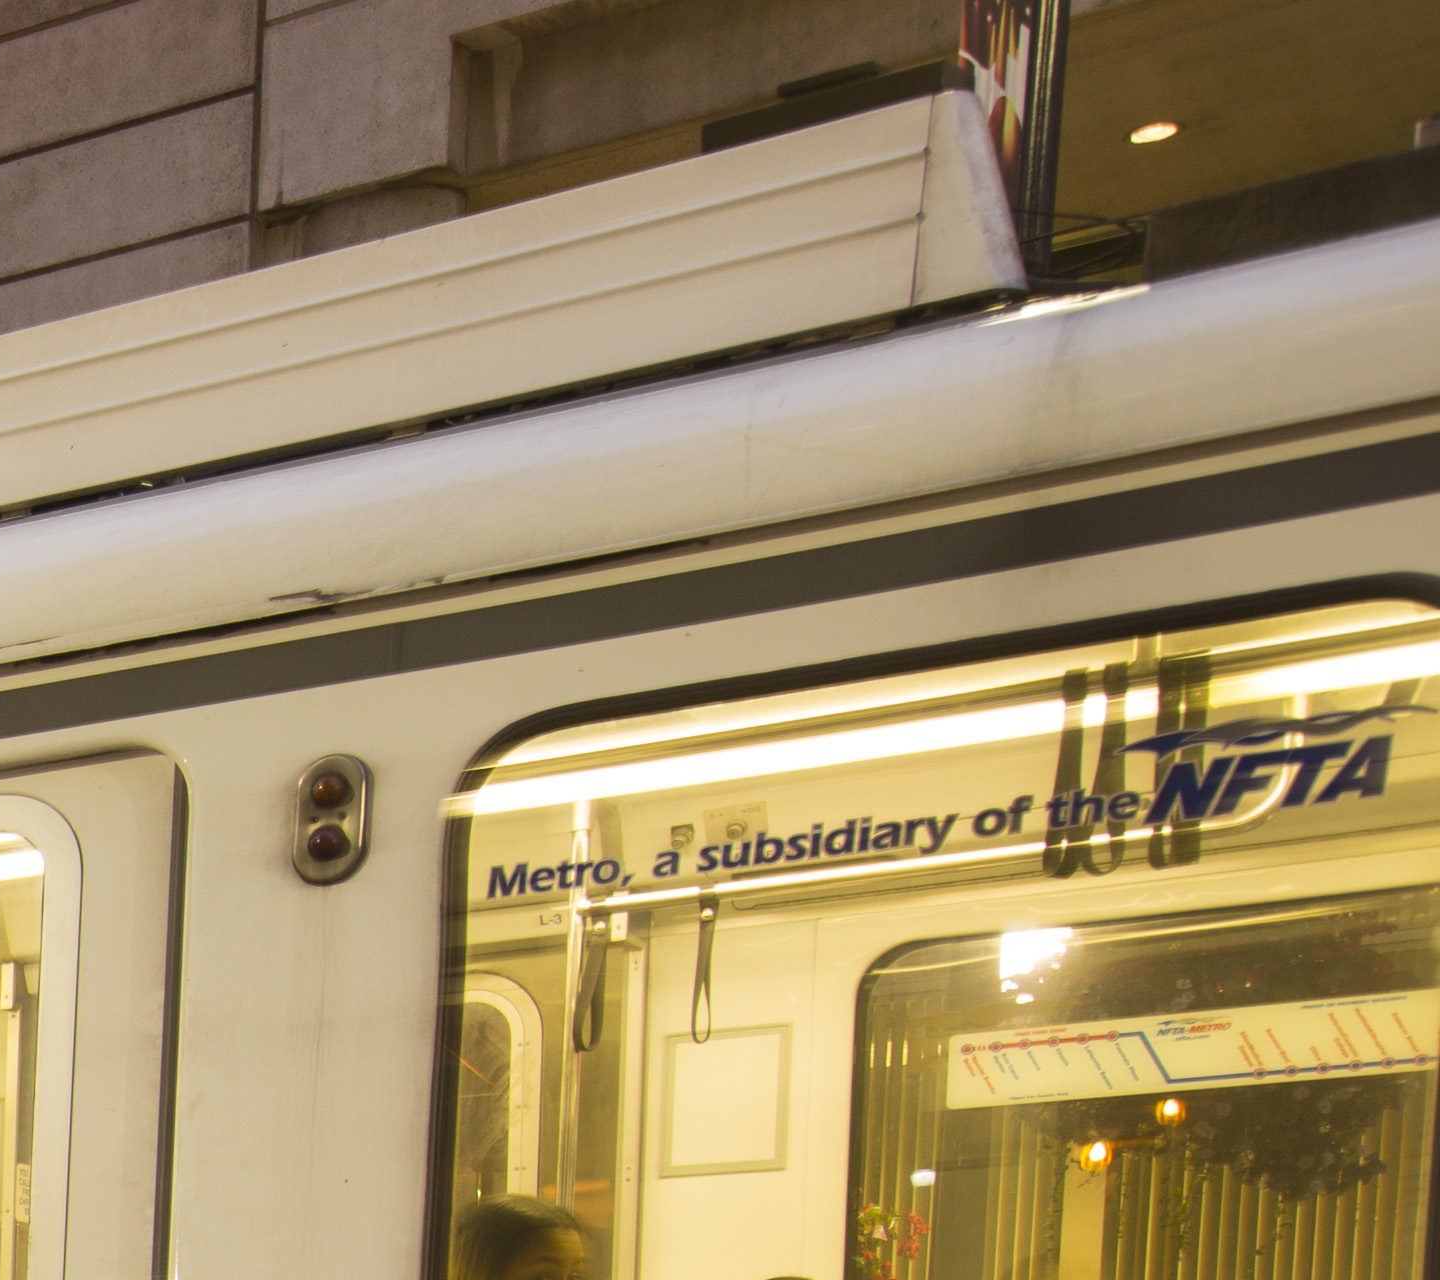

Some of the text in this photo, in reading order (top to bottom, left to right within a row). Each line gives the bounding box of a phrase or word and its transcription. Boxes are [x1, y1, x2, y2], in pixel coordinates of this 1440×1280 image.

[486, 734, 1396, 902] Metro, a subsidiary of the NFTA
[539, 914, 562, 926] L-3
